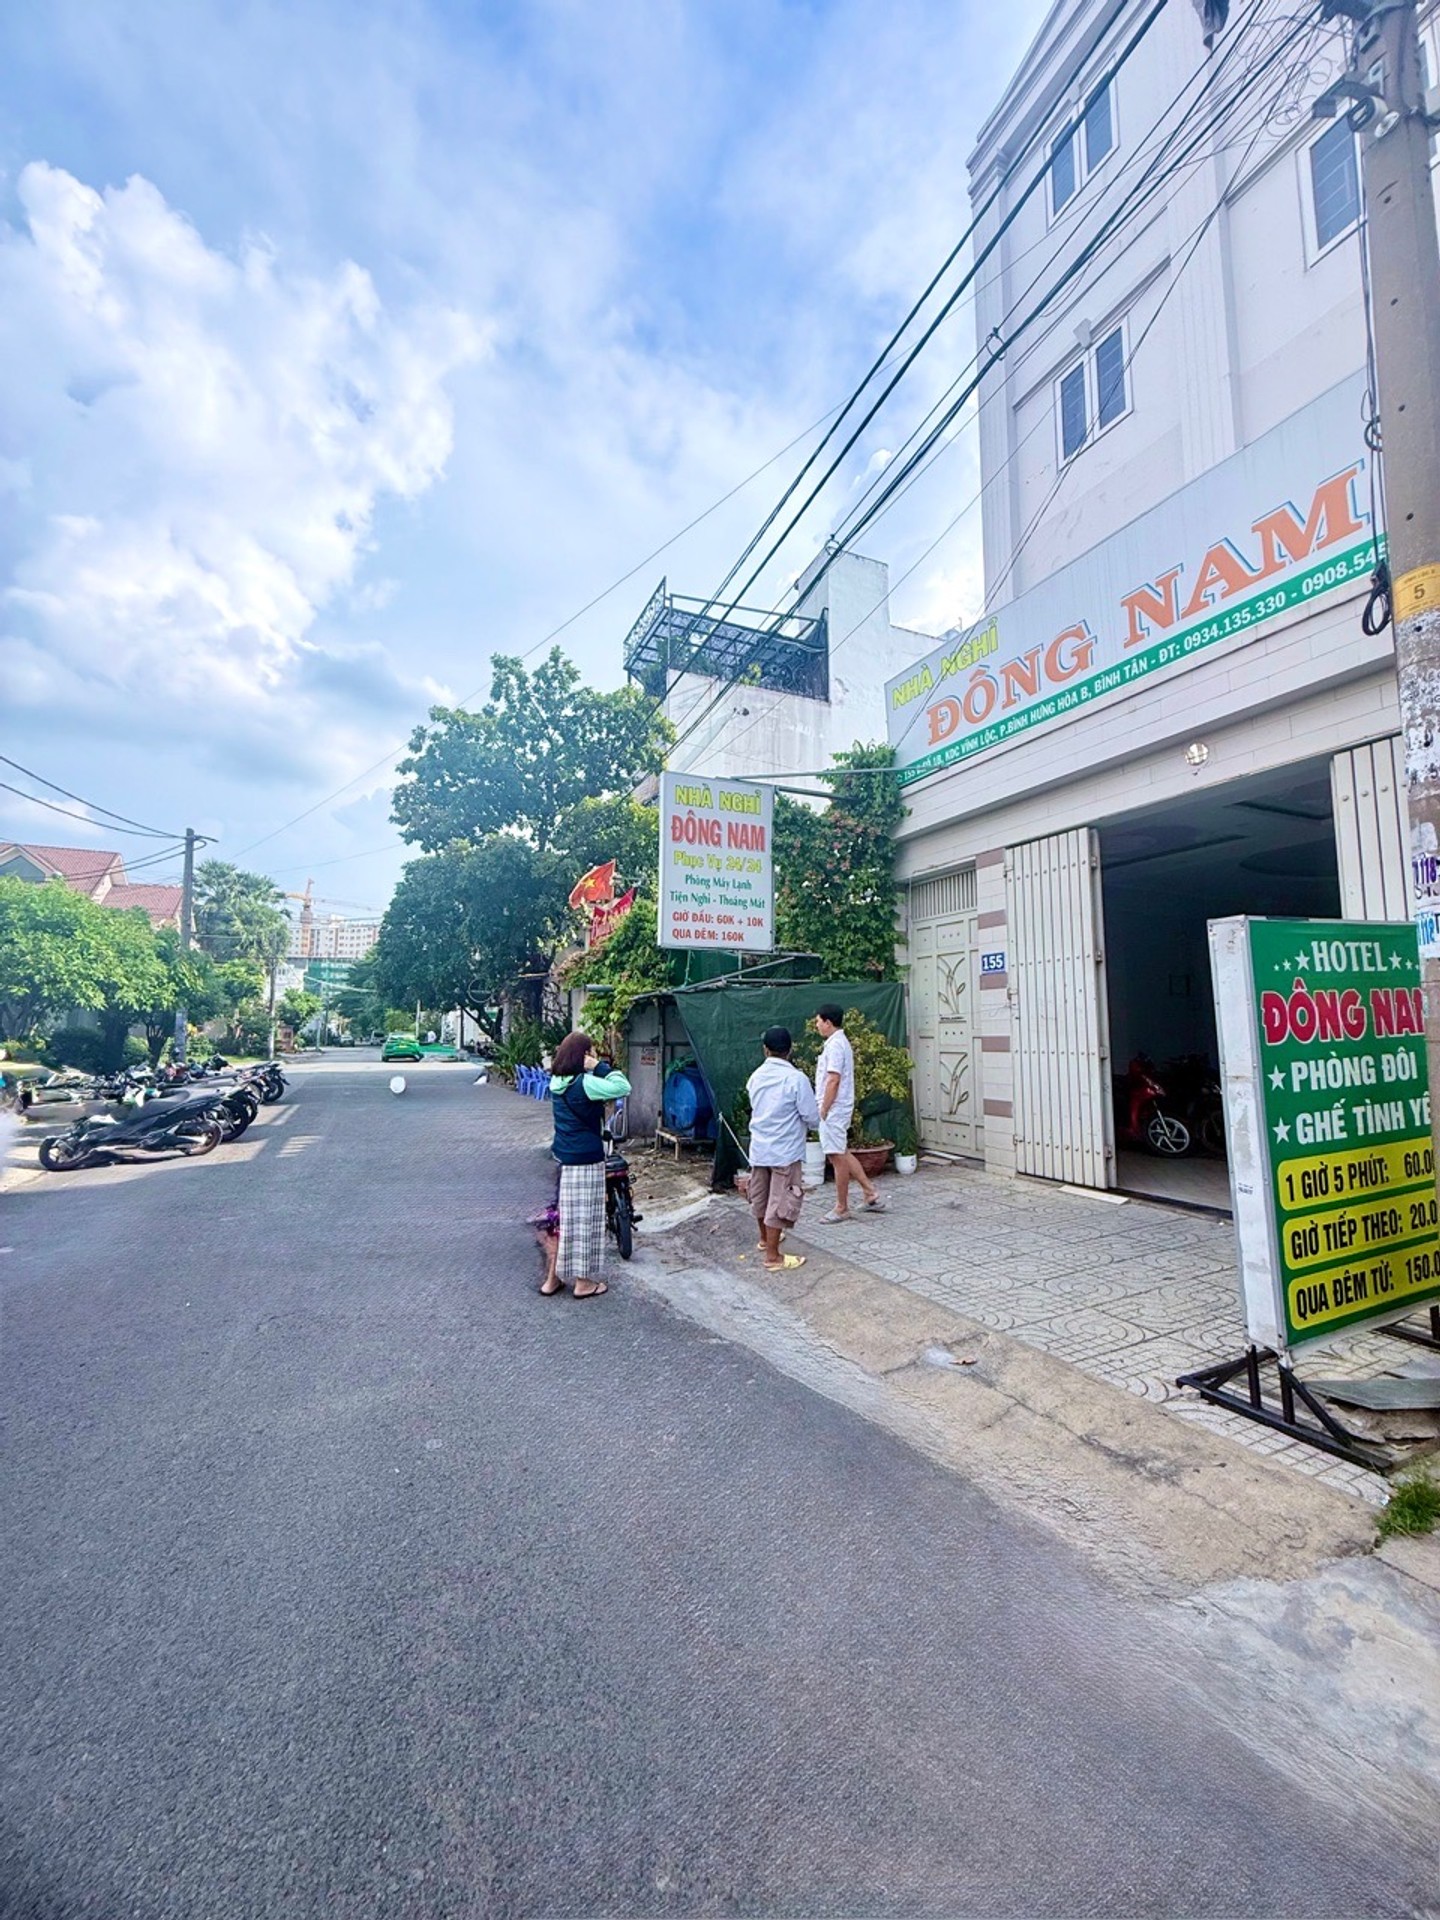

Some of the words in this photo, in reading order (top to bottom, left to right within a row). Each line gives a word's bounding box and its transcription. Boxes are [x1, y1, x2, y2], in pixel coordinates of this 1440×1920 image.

[926, 619, 1098, 747] ĐÔNG
[1120, 458, 1371, 650] NAM
[1414, 583, 1425, 600] 5
[893, 664, 935, 710] NHÀ
[940, 616, 999, 681] NGHỈ
[1080, 687, 1092, 700] B,
[1094, 670, 1121, 692] BÌNH
[1123, 656, 1148, 680] TÂN
[1158, 643, 1181, 663] ĐT:
[1184, 591, 1287, 651] 0934.135.330
[674, 783, 713, 810] NHÀ
[719, 788, 762, 815] NGHỈ
[671, 810, 723, 849] ĐÔNG
[727, 821, 766, 852] NAM
[670, 891, 688, 905] Tiện
[719, 895, 748, 910] Thoáng
[750, 898, 765, 909] Mát
[712, 877, 731, 891] Máy
[732, 879, 752, 893] Lạnh
[672, 928, 692, 941] QUA
[722, 931, 744, 942] 160K
[716, 916, 735, 926] 60K
[747, 917, 764, 927] 10K
[983, 955, 1003, 970] 155
[1311, 941, 1388, 972] HOTEL
[1261, 976, 1367, 1046] ĐÔNG
[1291, 1051, 1377, 1093] PHÒNG
[1381, 1046, 1418, 1083] ĐÔI
[1295, 1098, 1348, 1145] GHẾ
[1352, 1098, 1406, 1136] TÌNH
[1286, 1174, 1295, 1202] 1
[1301, 1161, 1329, 1199] GIỜ
[1334, 1165, 1344, 1193] 5
[1347, 1153, 1389, 1191] PHÚT:
[1404, 1148, 1434, 1178] 60.0
[1291, 1220, 1319, 1261] GIỜ
[1323, 1211, 1357, 1252] TIẾP
[1361, 1208, 1403, 1242] THEO:
[1296, 1282, 1330, 1321] QUA
[1332, 1269, 1368, 1308] ĐÊM
[1371, 1260, 1395, 1295] TỪ:
